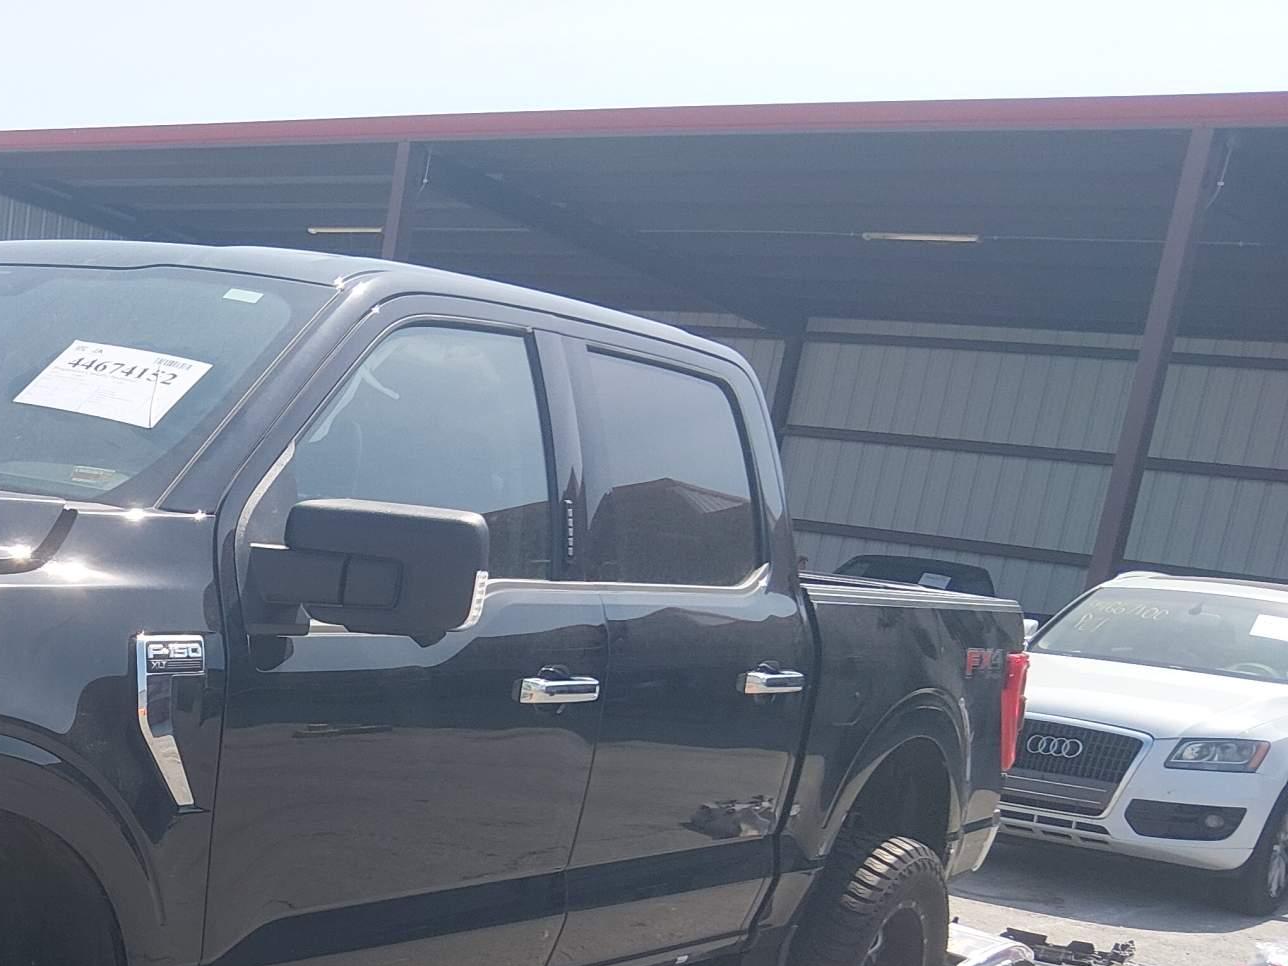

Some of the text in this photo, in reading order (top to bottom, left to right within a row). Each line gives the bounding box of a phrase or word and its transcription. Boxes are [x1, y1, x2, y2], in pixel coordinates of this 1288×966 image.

[67, 357, 178, 385] 44674152
[148, 643, 202, 659] F-150
[151, 661, 167, 669] XLT
